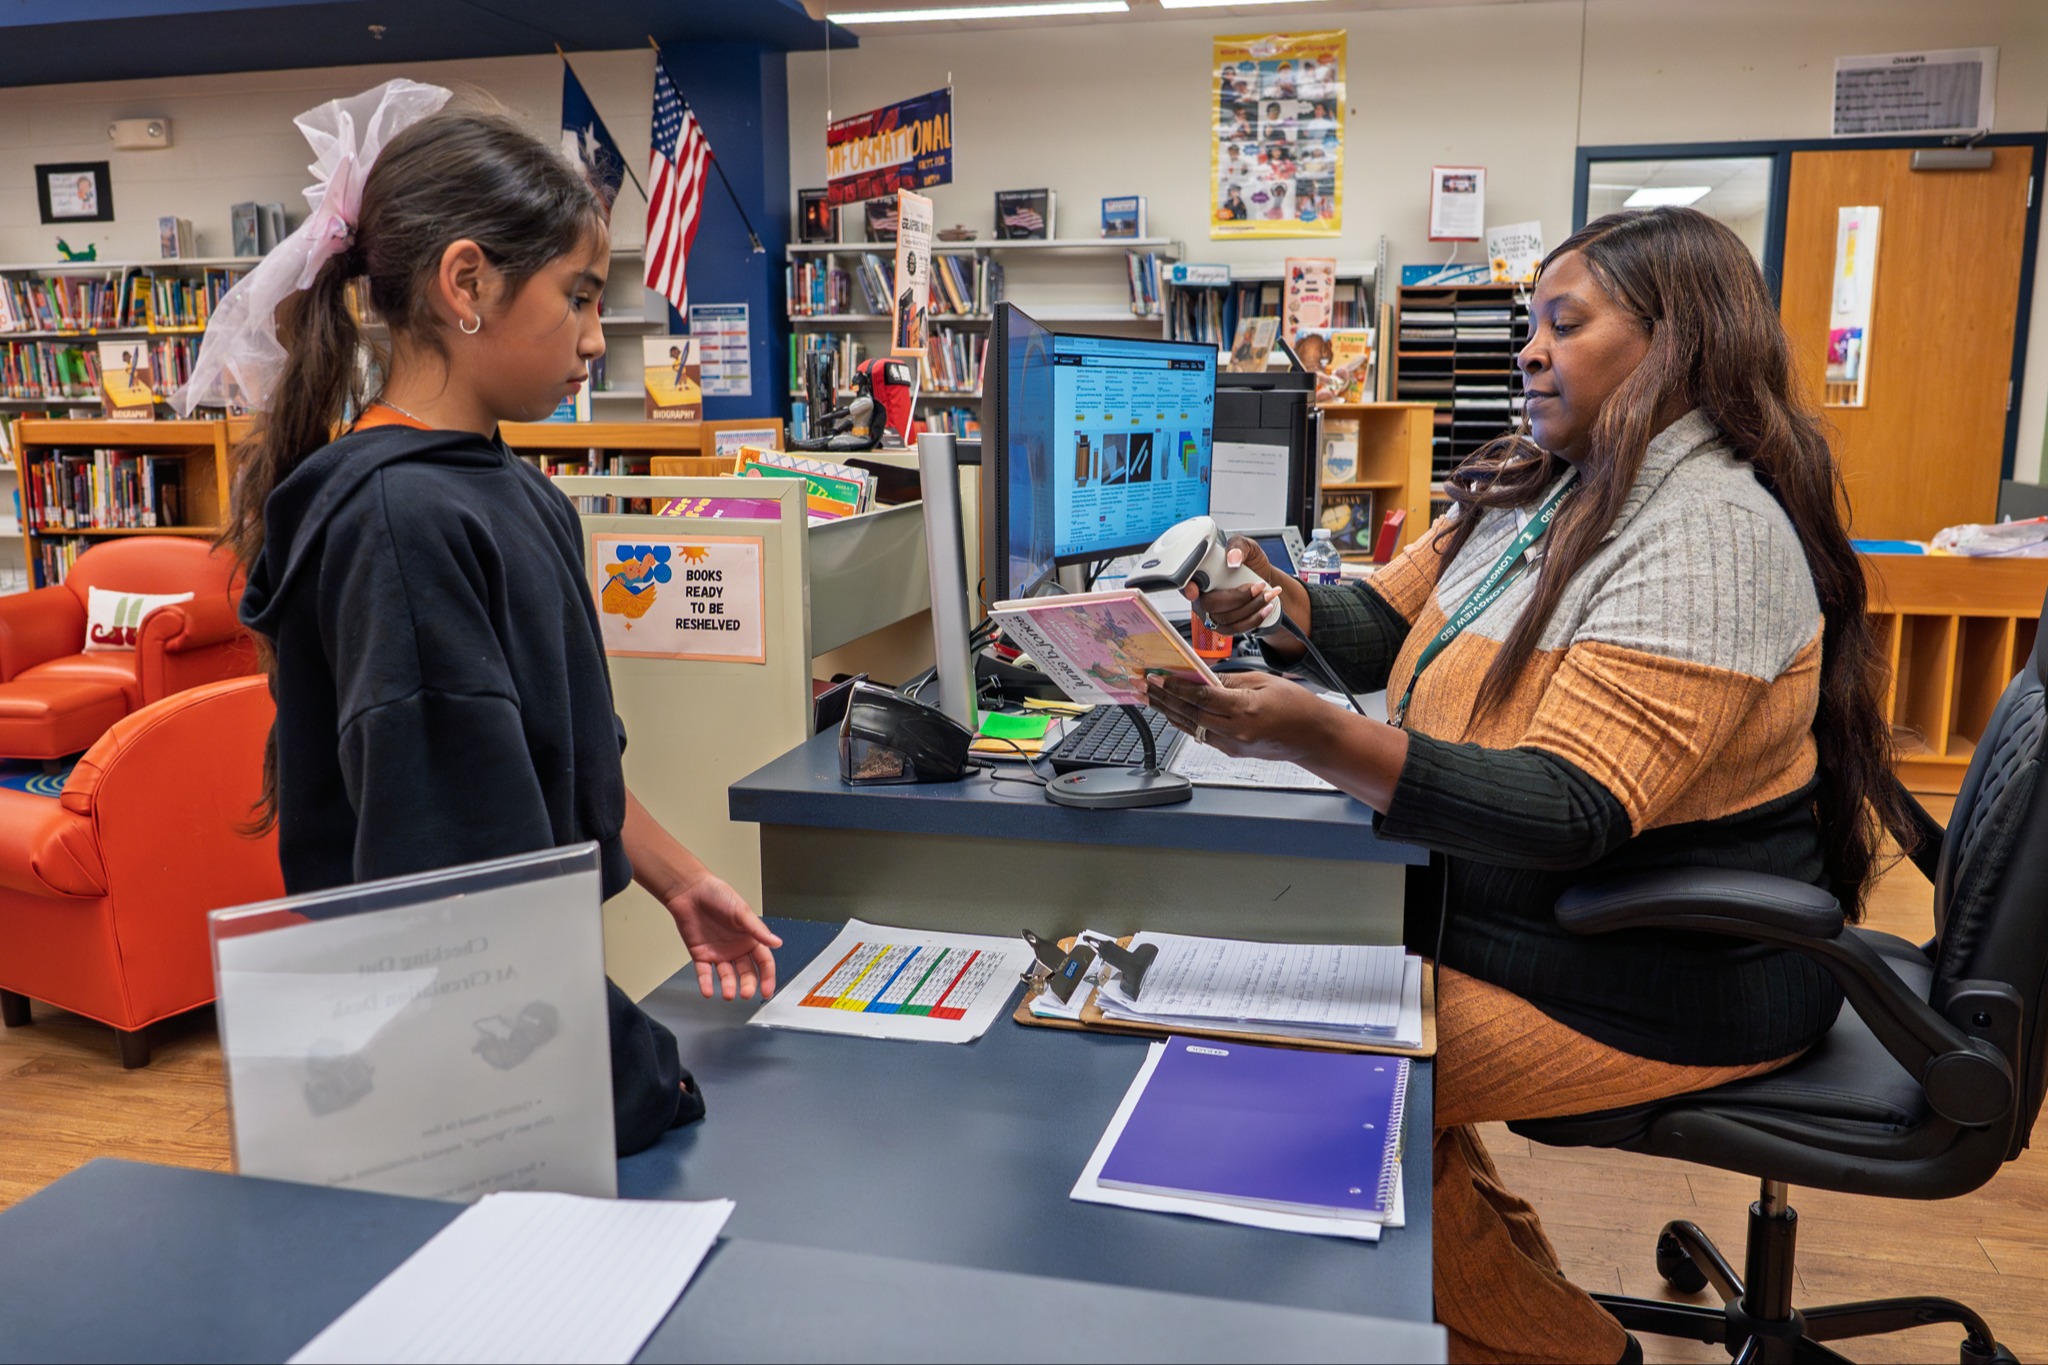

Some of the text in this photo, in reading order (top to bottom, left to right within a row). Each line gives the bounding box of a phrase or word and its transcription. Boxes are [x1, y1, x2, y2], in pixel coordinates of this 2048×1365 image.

[827, 113, 951, 176] INFORMATIONAL
[652, 408, 696, 421] BIOGRAPHY
[686, 569, 723, 582] BOOKS
[1473, 555, 1513, 602] LONGVIEW
[685, 586, 723, 598] READY
[690, 602, 724, 614] TO BE
[1440, 585, 1505, 642] LONGVIEW ISD
[675, 618, 741, 631] RESHELVED
[1013, 615, 1055, 650] jones
[1057, 661, 1094, 690] junie
